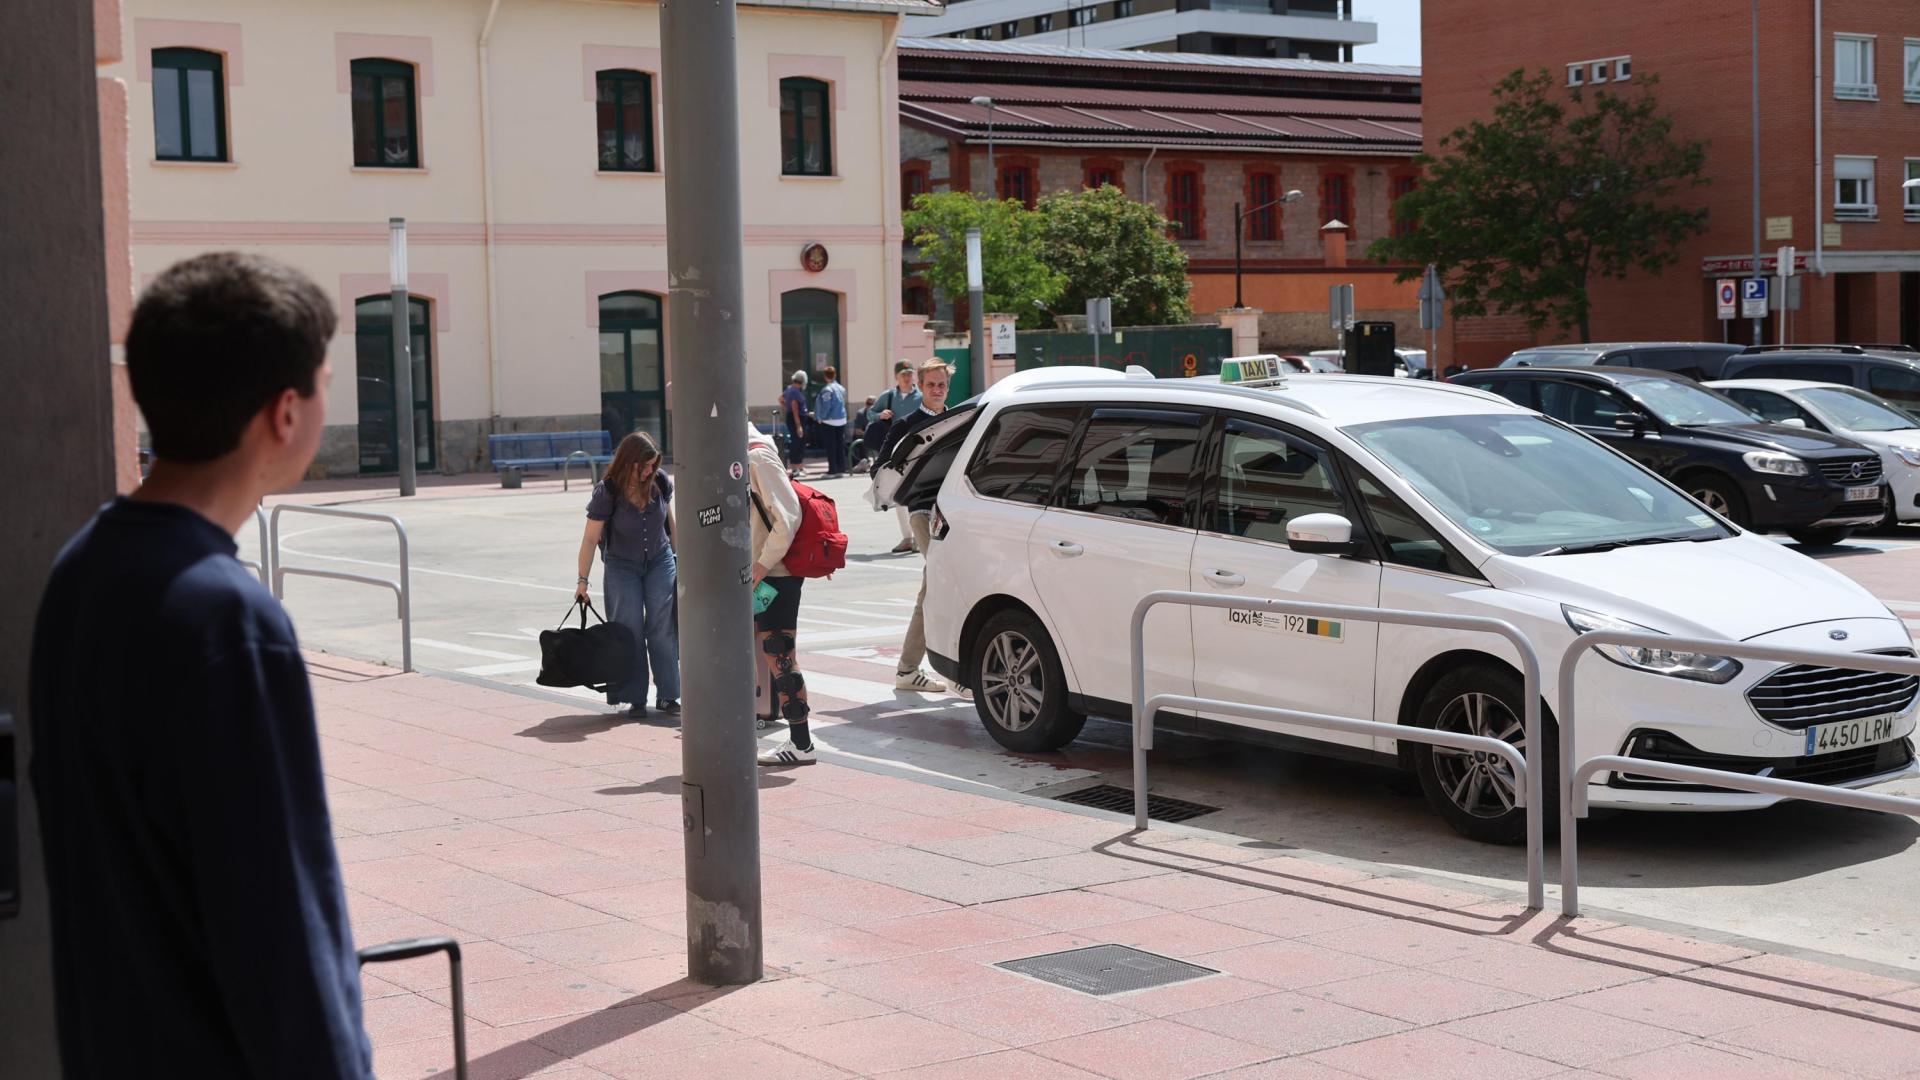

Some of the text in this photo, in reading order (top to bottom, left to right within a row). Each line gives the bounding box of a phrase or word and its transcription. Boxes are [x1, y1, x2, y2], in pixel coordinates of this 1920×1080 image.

[1745, 281, 1759, 298] P
[1240, 360, 1267, 377] TAXI
[1283, 614, 1305, 633] 192
[1819, 723, 1860, 750] 4450
[1864, 716, 1893, 743] LRM
